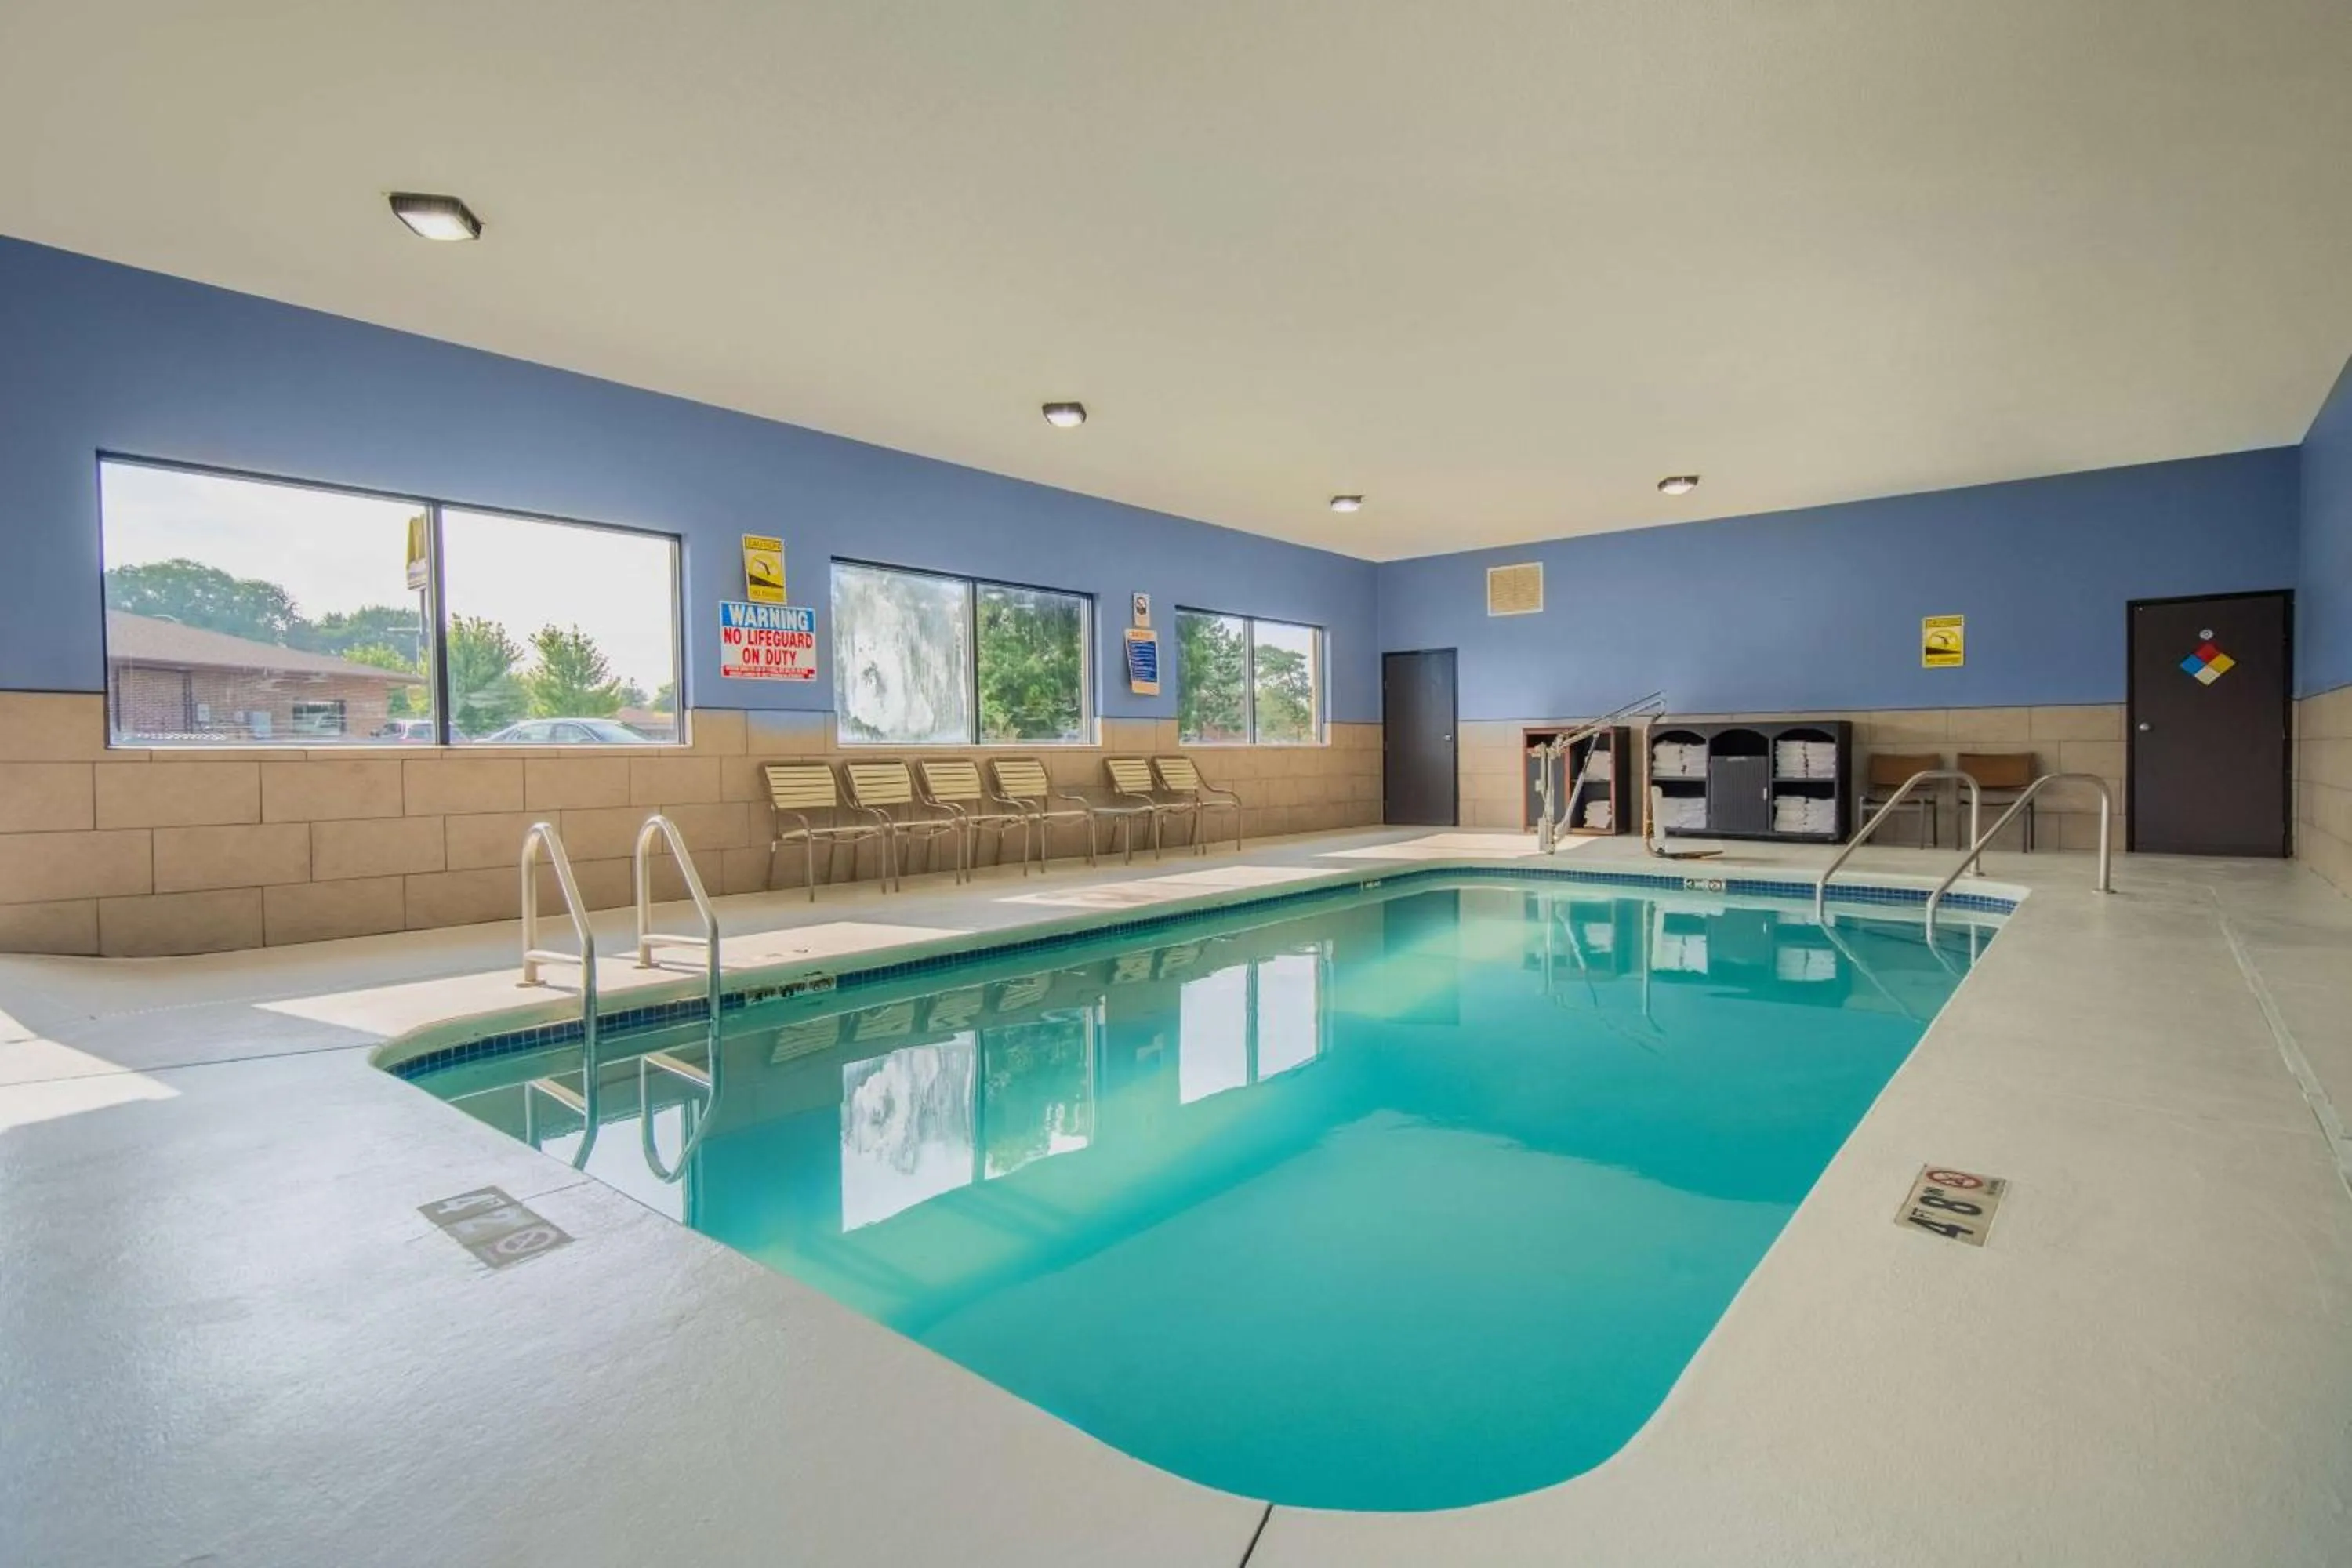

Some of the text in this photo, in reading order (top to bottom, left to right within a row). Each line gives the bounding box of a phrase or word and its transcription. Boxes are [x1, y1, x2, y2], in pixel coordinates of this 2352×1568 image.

[728, 604, 808, 630] WARNING
[724, 628, 813, 648] NO LIFEGUARD
[742, 648, 797, 666] ON DUTY
